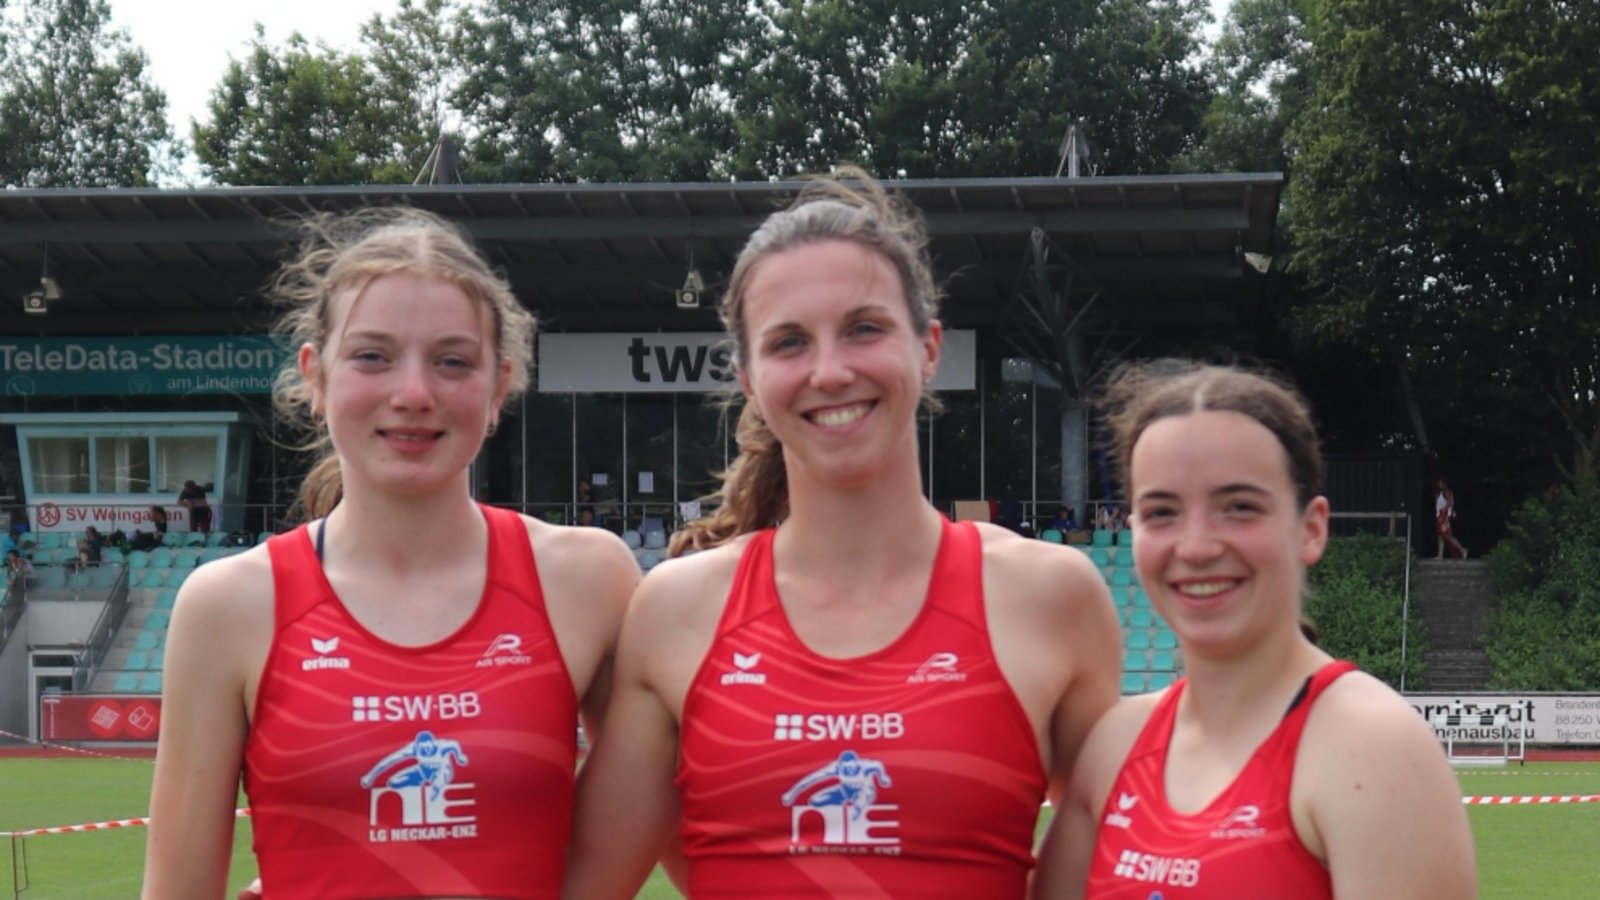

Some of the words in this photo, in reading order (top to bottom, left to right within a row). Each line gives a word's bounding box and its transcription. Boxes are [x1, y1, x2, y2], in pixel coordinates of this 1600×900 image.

[0, 343, 275, 370] TeleData-Stadion
[627, 337, 737, 382] tws
[167, 378, 191, 389] am
[66, 507, 88, 521] SV
[92, 507, 183, 524] Weingaen
[302, 655, 350, 671] erima
[720, 670, 766, 686] erima
[1434, 724, 1535, 740] nenausbau
[369, 828, 387, 842] LG
[390, 824, 477, 841] NECKAR-ENZ
